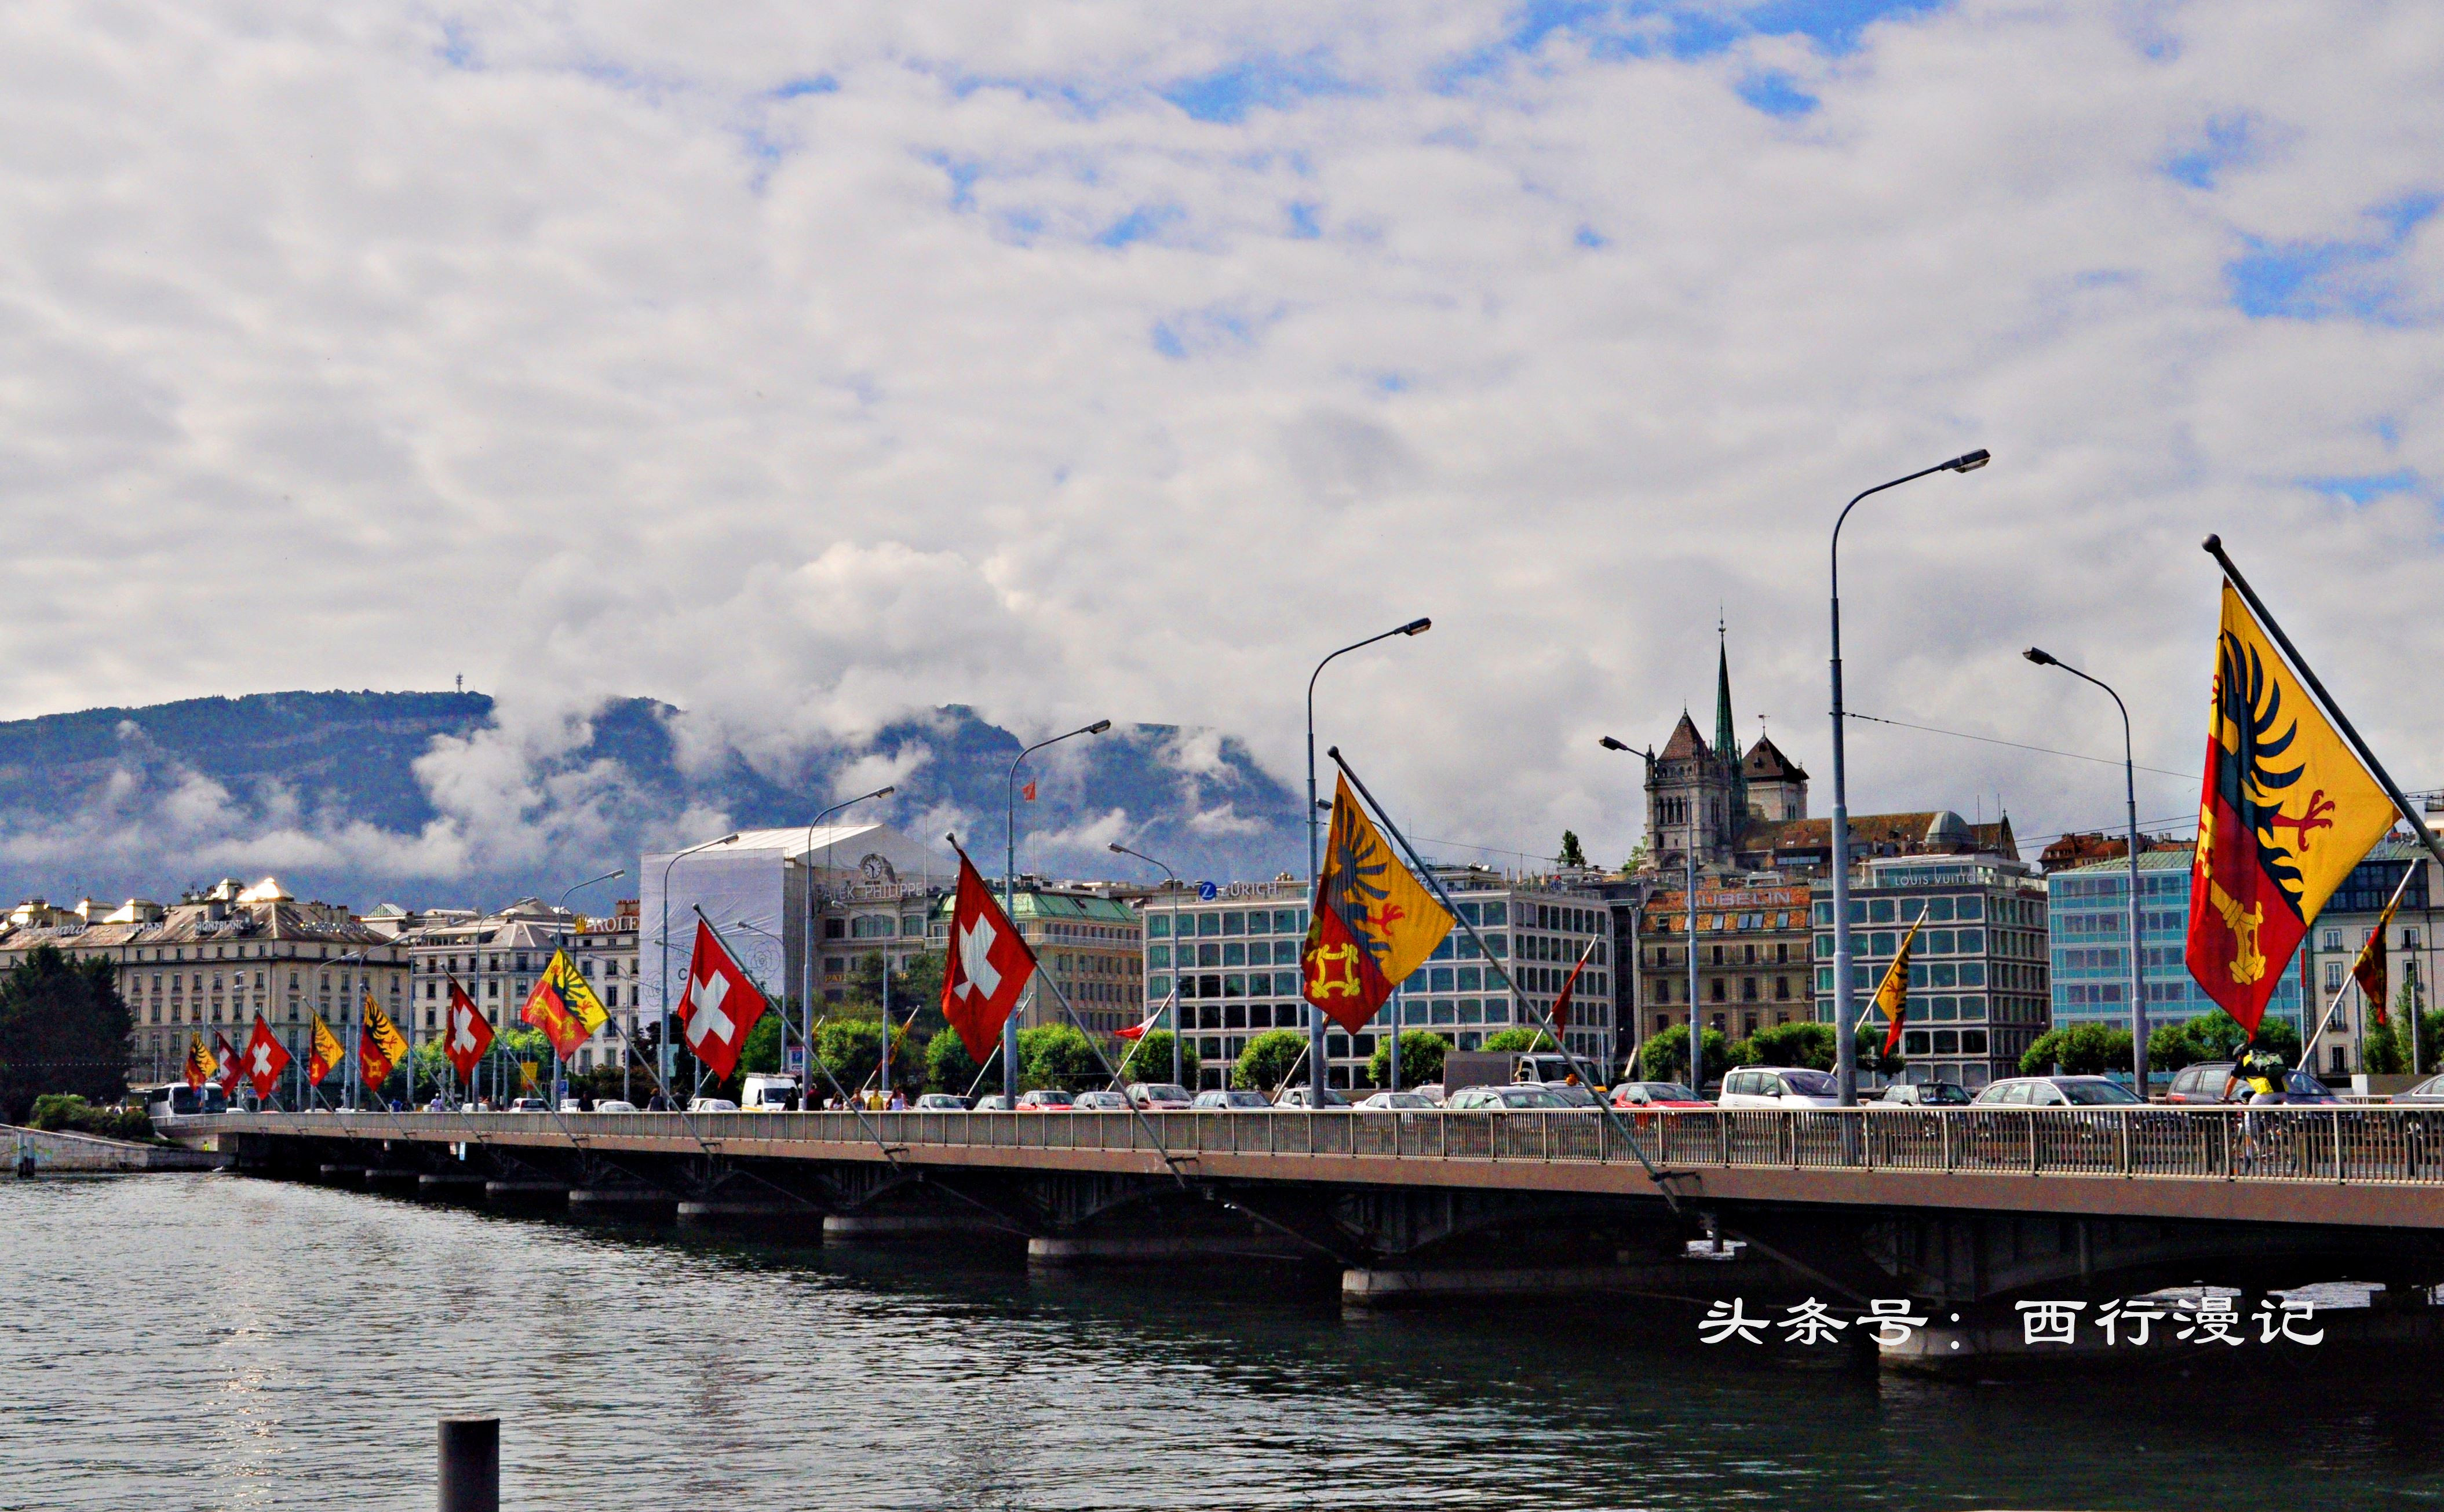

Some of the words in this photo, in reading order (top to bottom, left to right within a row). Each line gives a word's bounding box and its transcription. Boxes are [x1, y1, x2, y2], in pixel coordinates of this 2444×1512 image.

[1895, 876, 1929, 886] LOUIS
[816, 885, 855, 900] PATEK
[866, 882, 923, 899] PHILIPPE
[593, 916, 639, 932] ROLE
